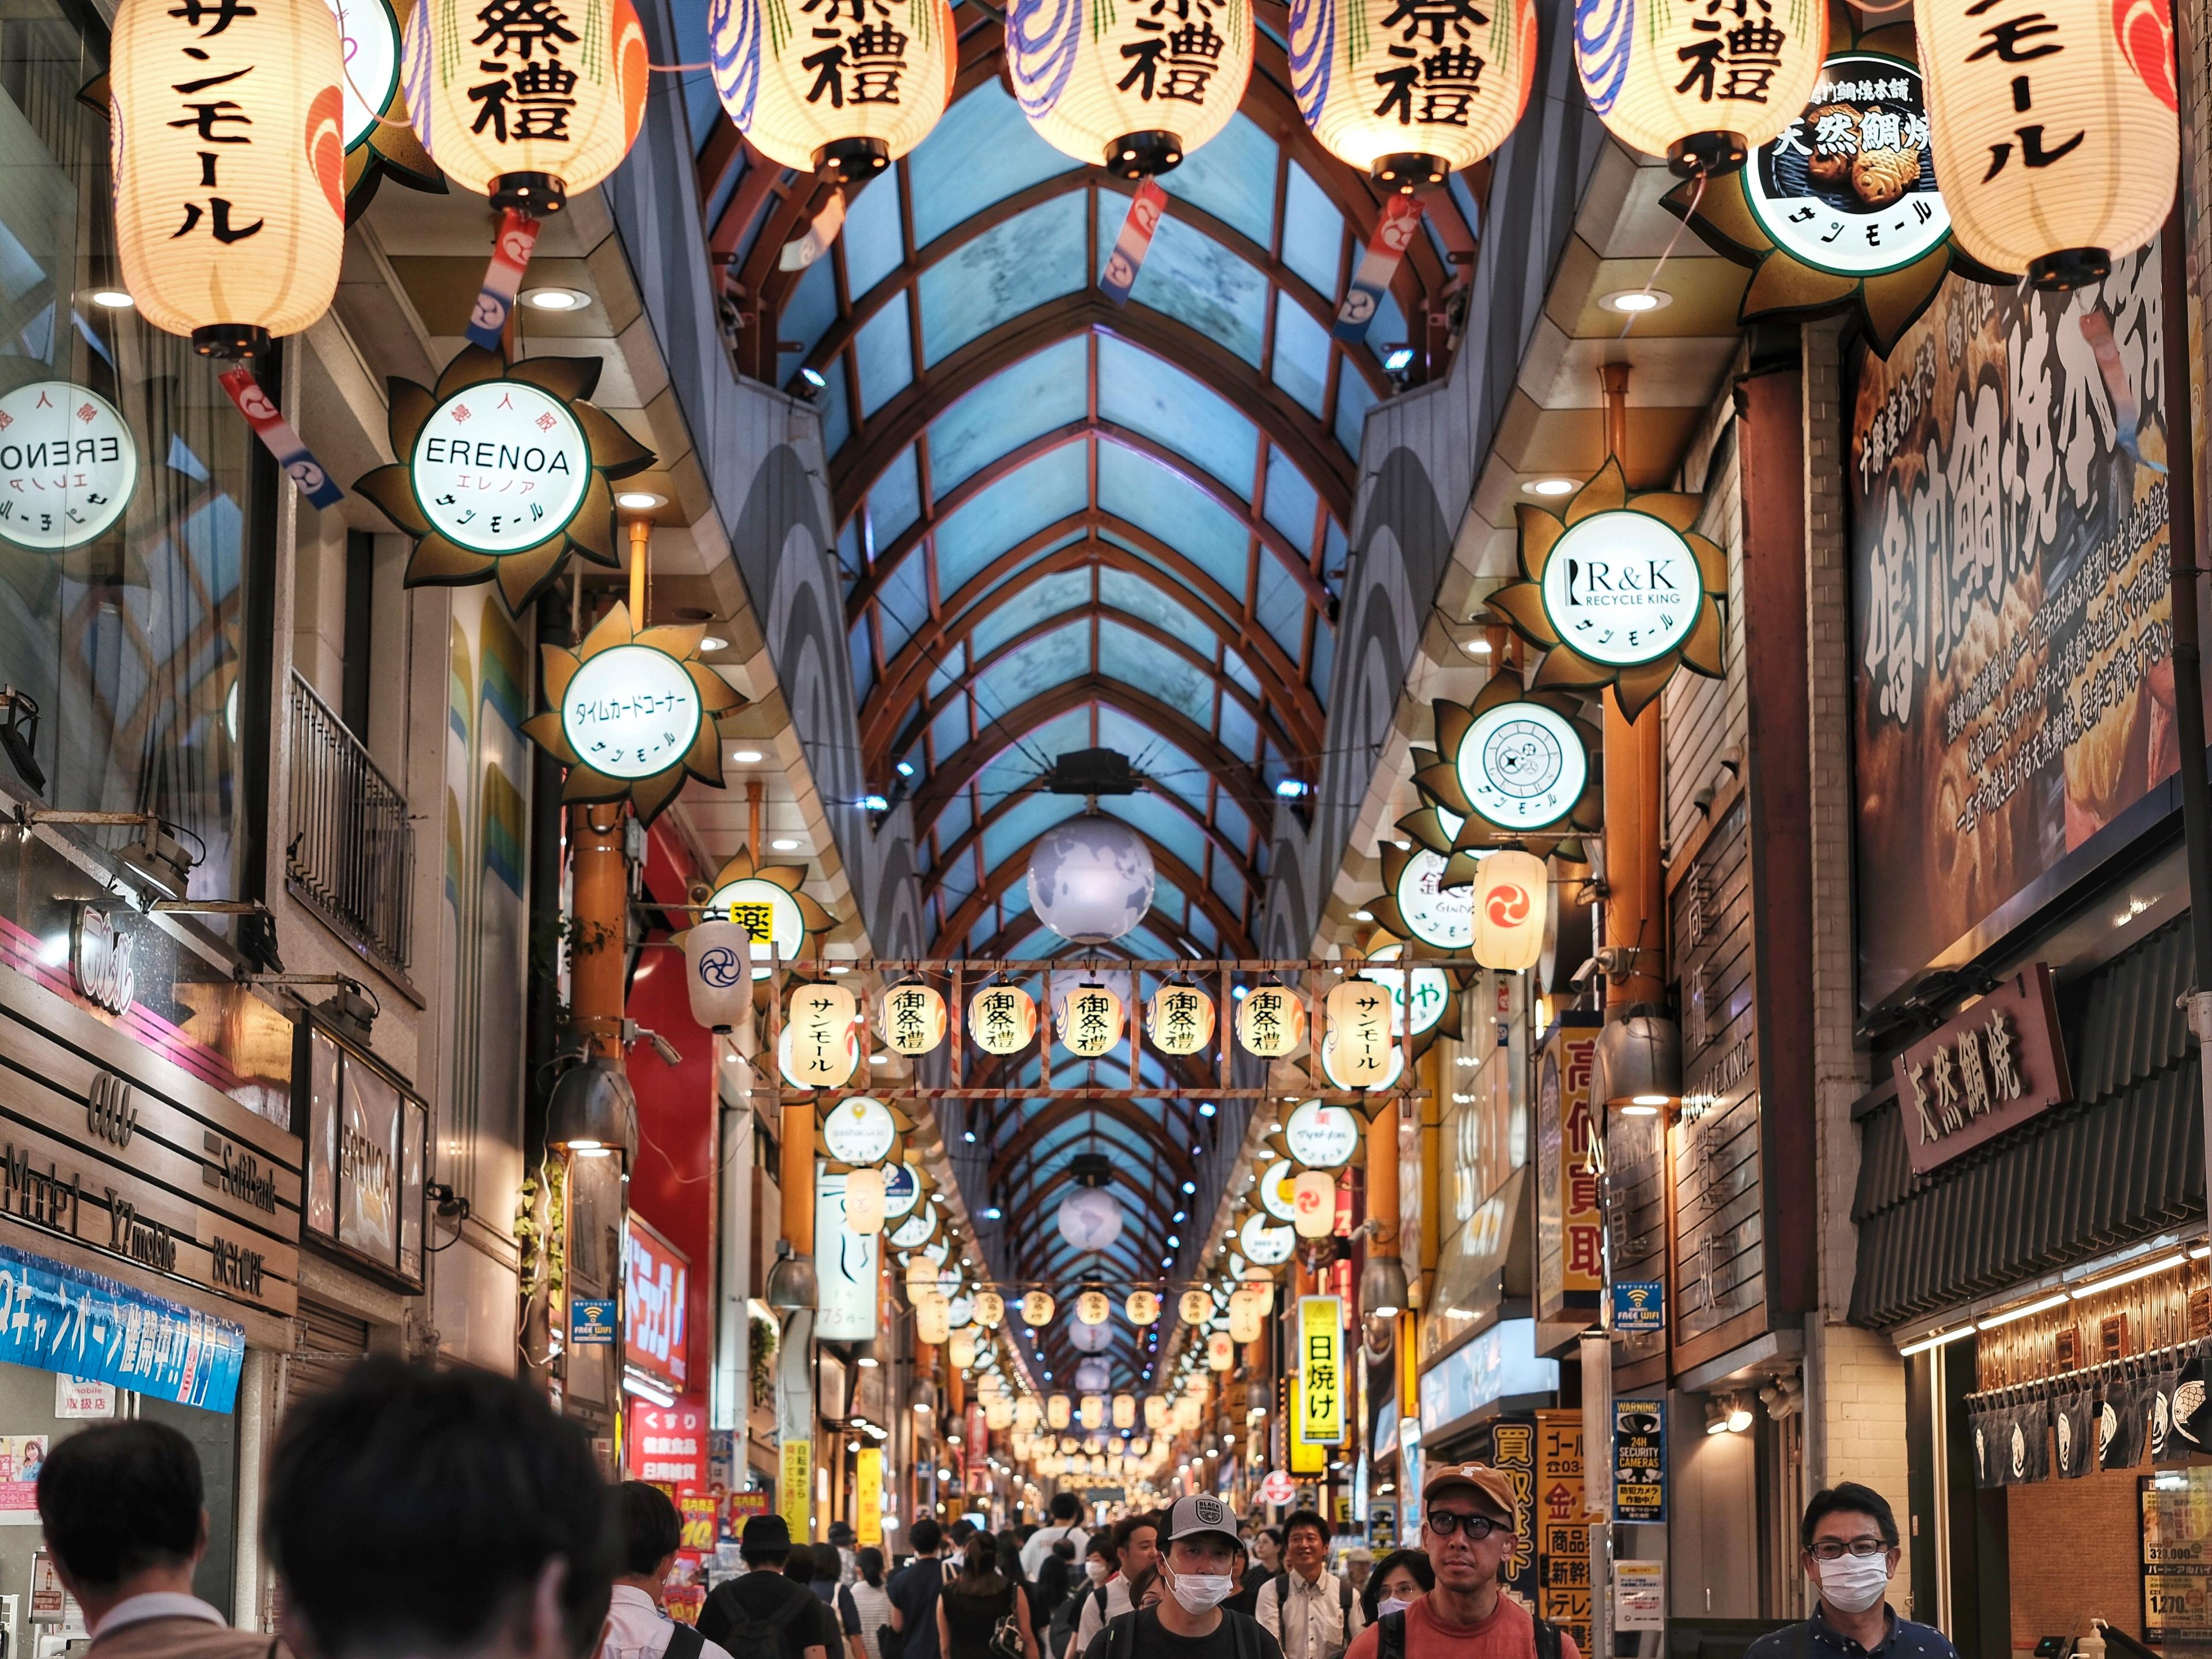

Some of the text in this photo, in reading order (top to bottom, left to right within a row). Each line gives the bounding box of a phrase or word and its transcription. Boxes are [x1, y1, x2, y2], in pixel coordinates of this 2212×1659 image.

[1788, 199, 1933, 247] サンモール
[450, 392, 559, 434] 婦人服
[426, 438, 570, 475] ERENOA
[456, 475, 536, 495] エレノア
[435, 494, 544, 533] サンモール
[1586, 594, 1681, 606] RECYCLE KING
[1575, 612, 1673, 646] サンモール
[575, 690, 687, 726] タイムカードコーナー
[591, 732, 676, 763] サンモール
[1478, 785, 1557, 815] サンモール
[734, 904, 770, 941] 薬
[808, 998, 835, 1073] サンモール
[891, 990, 926, 1049] 御祭禮
[982, 991, 1015, 1049] 御祭禮
[1076, 993, 1109, 1051] 御祭禮
[1165, 991, 1198, 1051] 御祭禮
[1249, 991, 1282, 1051] 御祭禮
[1355, 997, 1381, 1070] サンモール
[1909, 1008, 2020, 1146] 天然鯛焼
[89, 1070, 137, 1148] au
[222, 1143, 276, 1215] SoftBank
[213, 1236, 265, 1297] BIGLOBE
[574, 1326, 612, 1334] FREE WIFI
[1618, 1311, 1659, 1320] FREE WIFI
[1308, 1335, 1335, 1420] 日焼け
[66, 1397, 106, 1410] 取扱店
[644, 1412, 698, 1430] くすり
[1617, 1402, 1660, 1412] WARNING!
[1619, 1446, 1659, 1457] SECURITY
[1631, 1437, 1647, 1447] 24H
[1619, 1457, 1660, 1468] CAMERAS
[1199, 1501, 1219, 1509] BLACK
[1620, 1486, 1658, 1495] 防犯カメラ
[1551, 1562, 1590, 1586] 新幹
